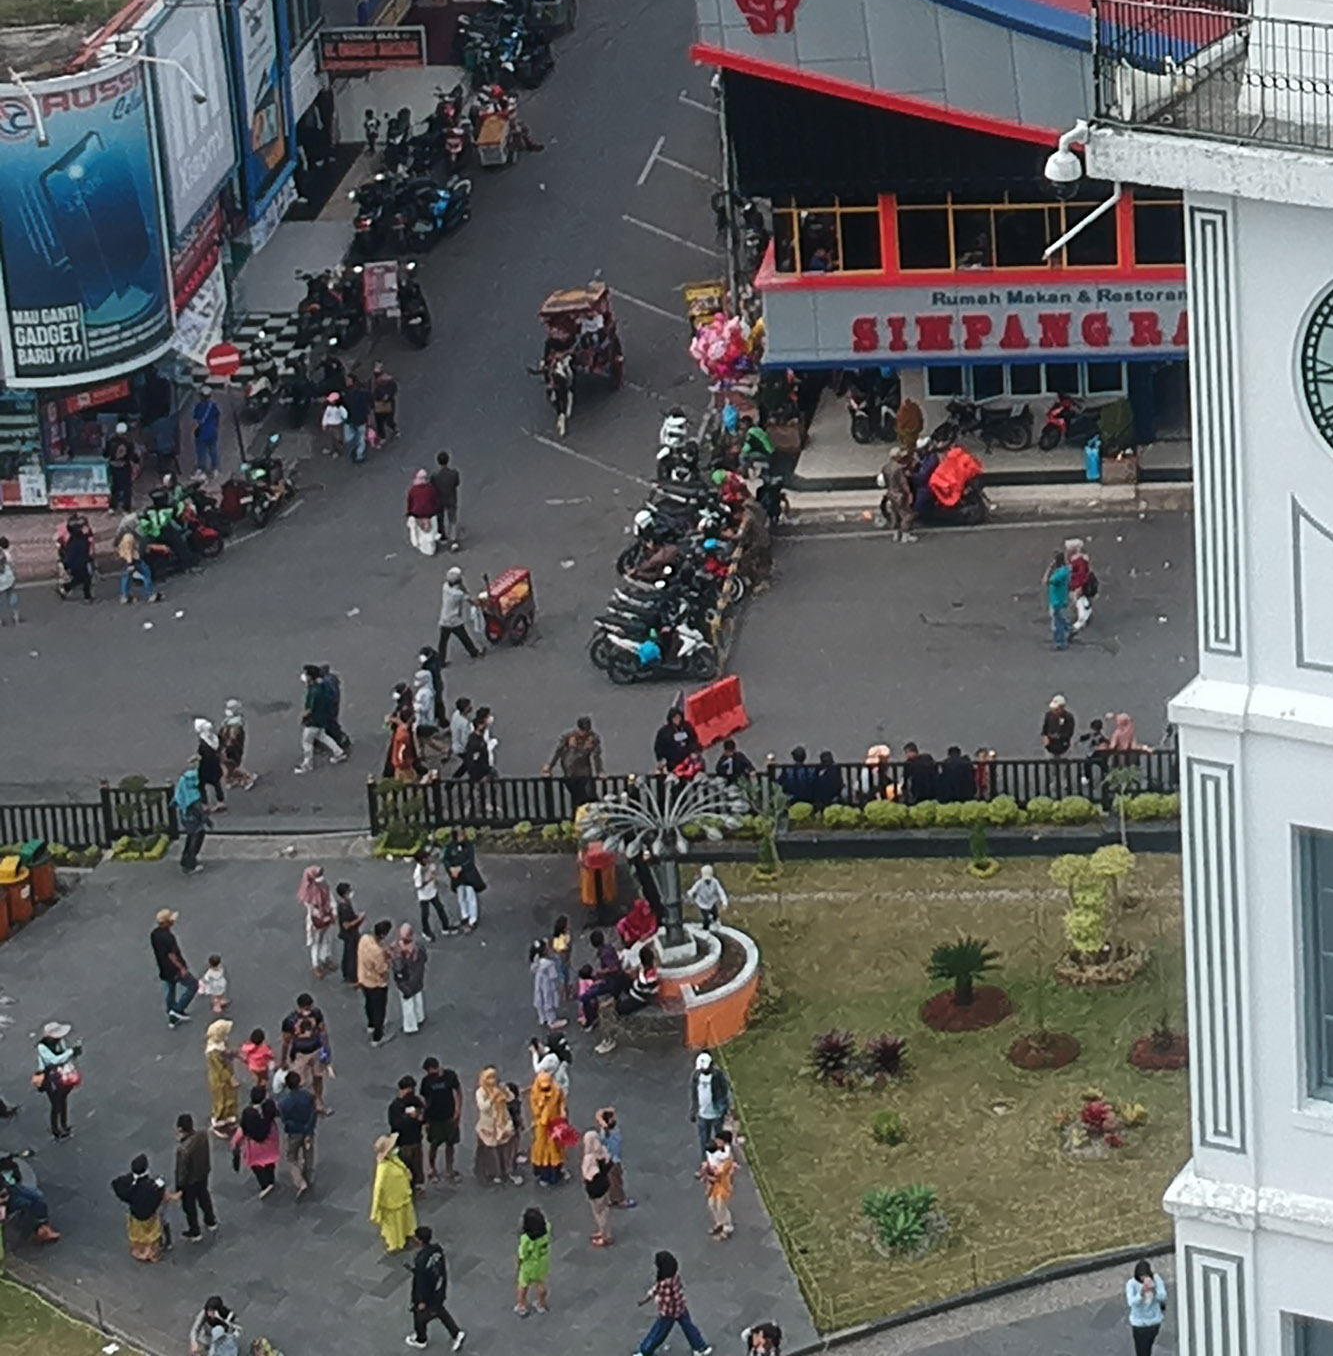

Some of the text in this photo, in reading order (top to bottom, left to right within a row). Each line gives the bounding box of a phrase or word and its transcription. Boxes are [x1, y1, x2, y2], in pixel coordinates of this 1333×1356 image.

[932, 288, 1187, 306] Rumah Makan & Restoran
[14, 322, 79, 348] GADGET
[852, 313, 1113, 353] SIMPANG
[17, 343, 83, 365] BARU ???
